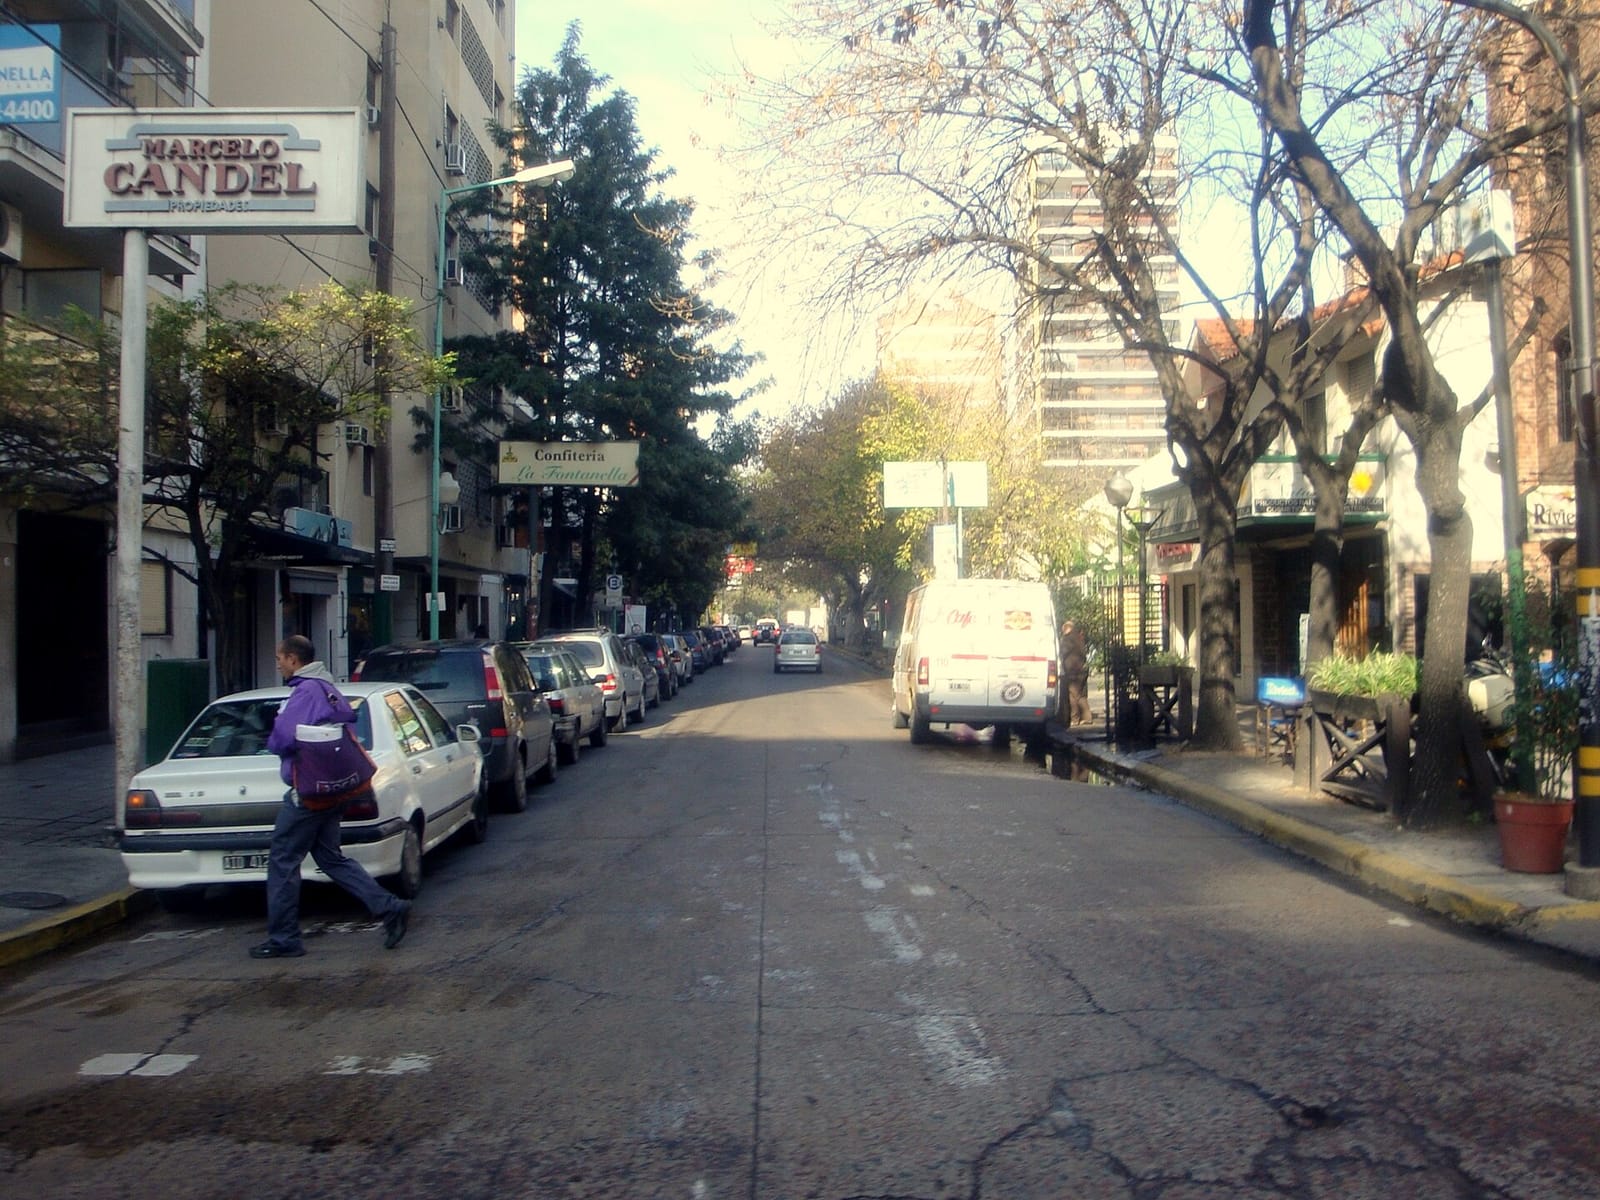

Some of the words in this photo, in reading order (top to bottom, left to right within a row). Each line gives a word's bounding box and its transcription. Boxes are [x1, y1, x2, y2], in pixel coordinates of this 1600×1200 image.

[142, 138, 281, 160] MARCELO
[103, 161, 318, 196] CANDEL
[534, 448, 606, 462] Confiteria
[517, 464, 535, 482] La
[542, 464, 630, 481] Fontanella
